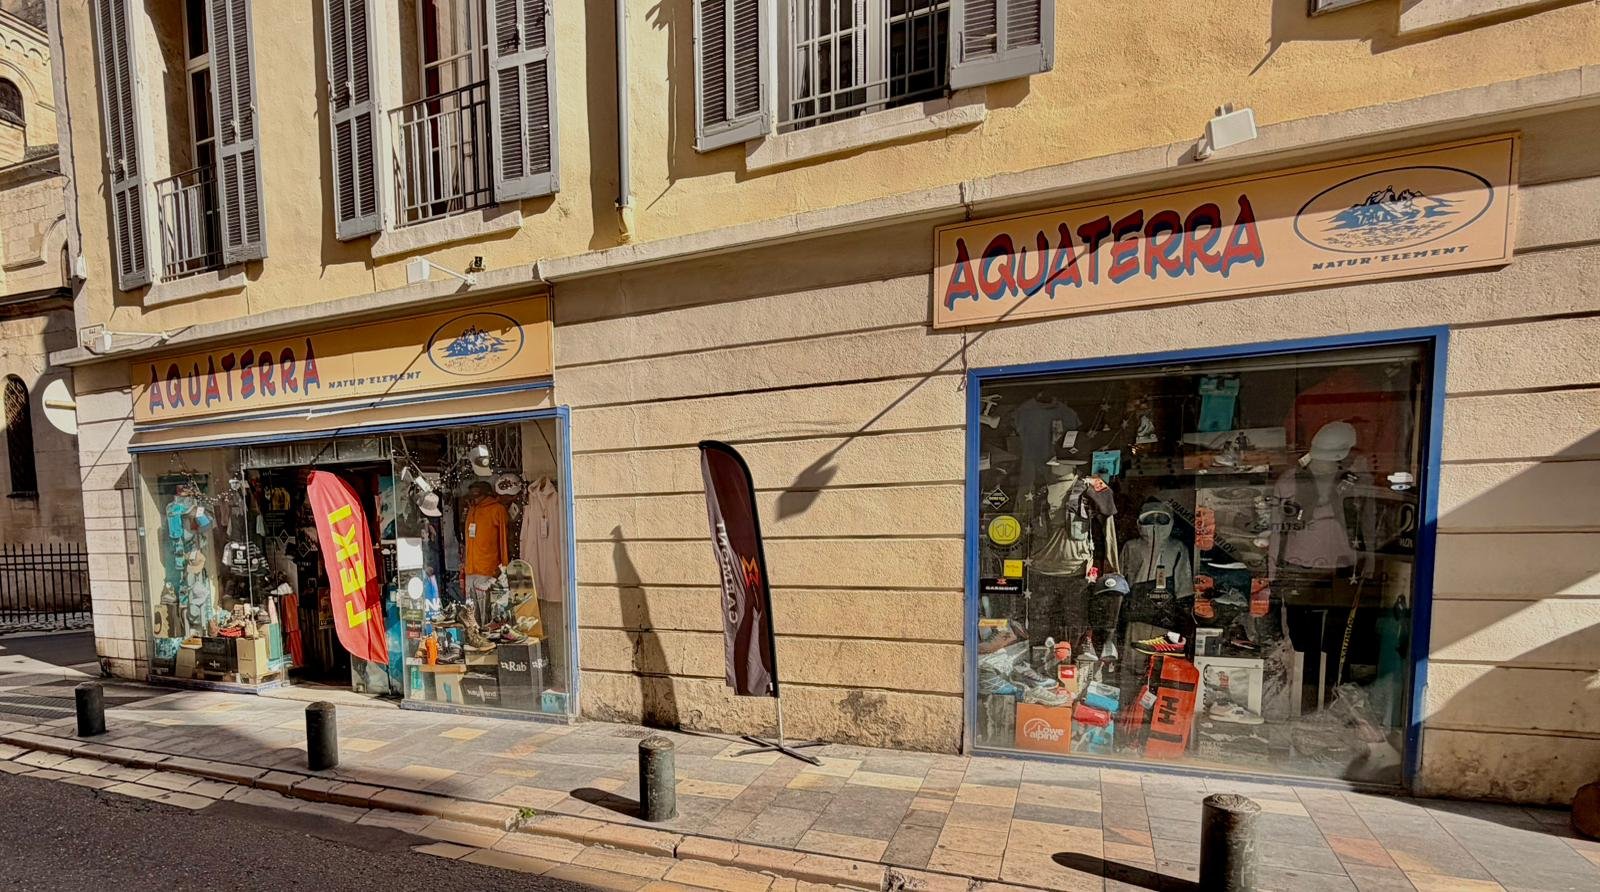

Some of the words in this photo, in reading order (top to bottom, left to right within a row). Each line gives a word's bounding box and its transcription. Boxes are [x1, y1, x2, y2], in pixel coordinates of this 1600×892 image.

[944, 194, 1265, 311] AQUATERRA
[1312, 245, 1469, 270] NATUR'ELEMENT
[150, 337, 320, 415] AQUATERRA
[509, 661, 527, 672] Rab
[1037, 725, 1064, 737] Lowe
